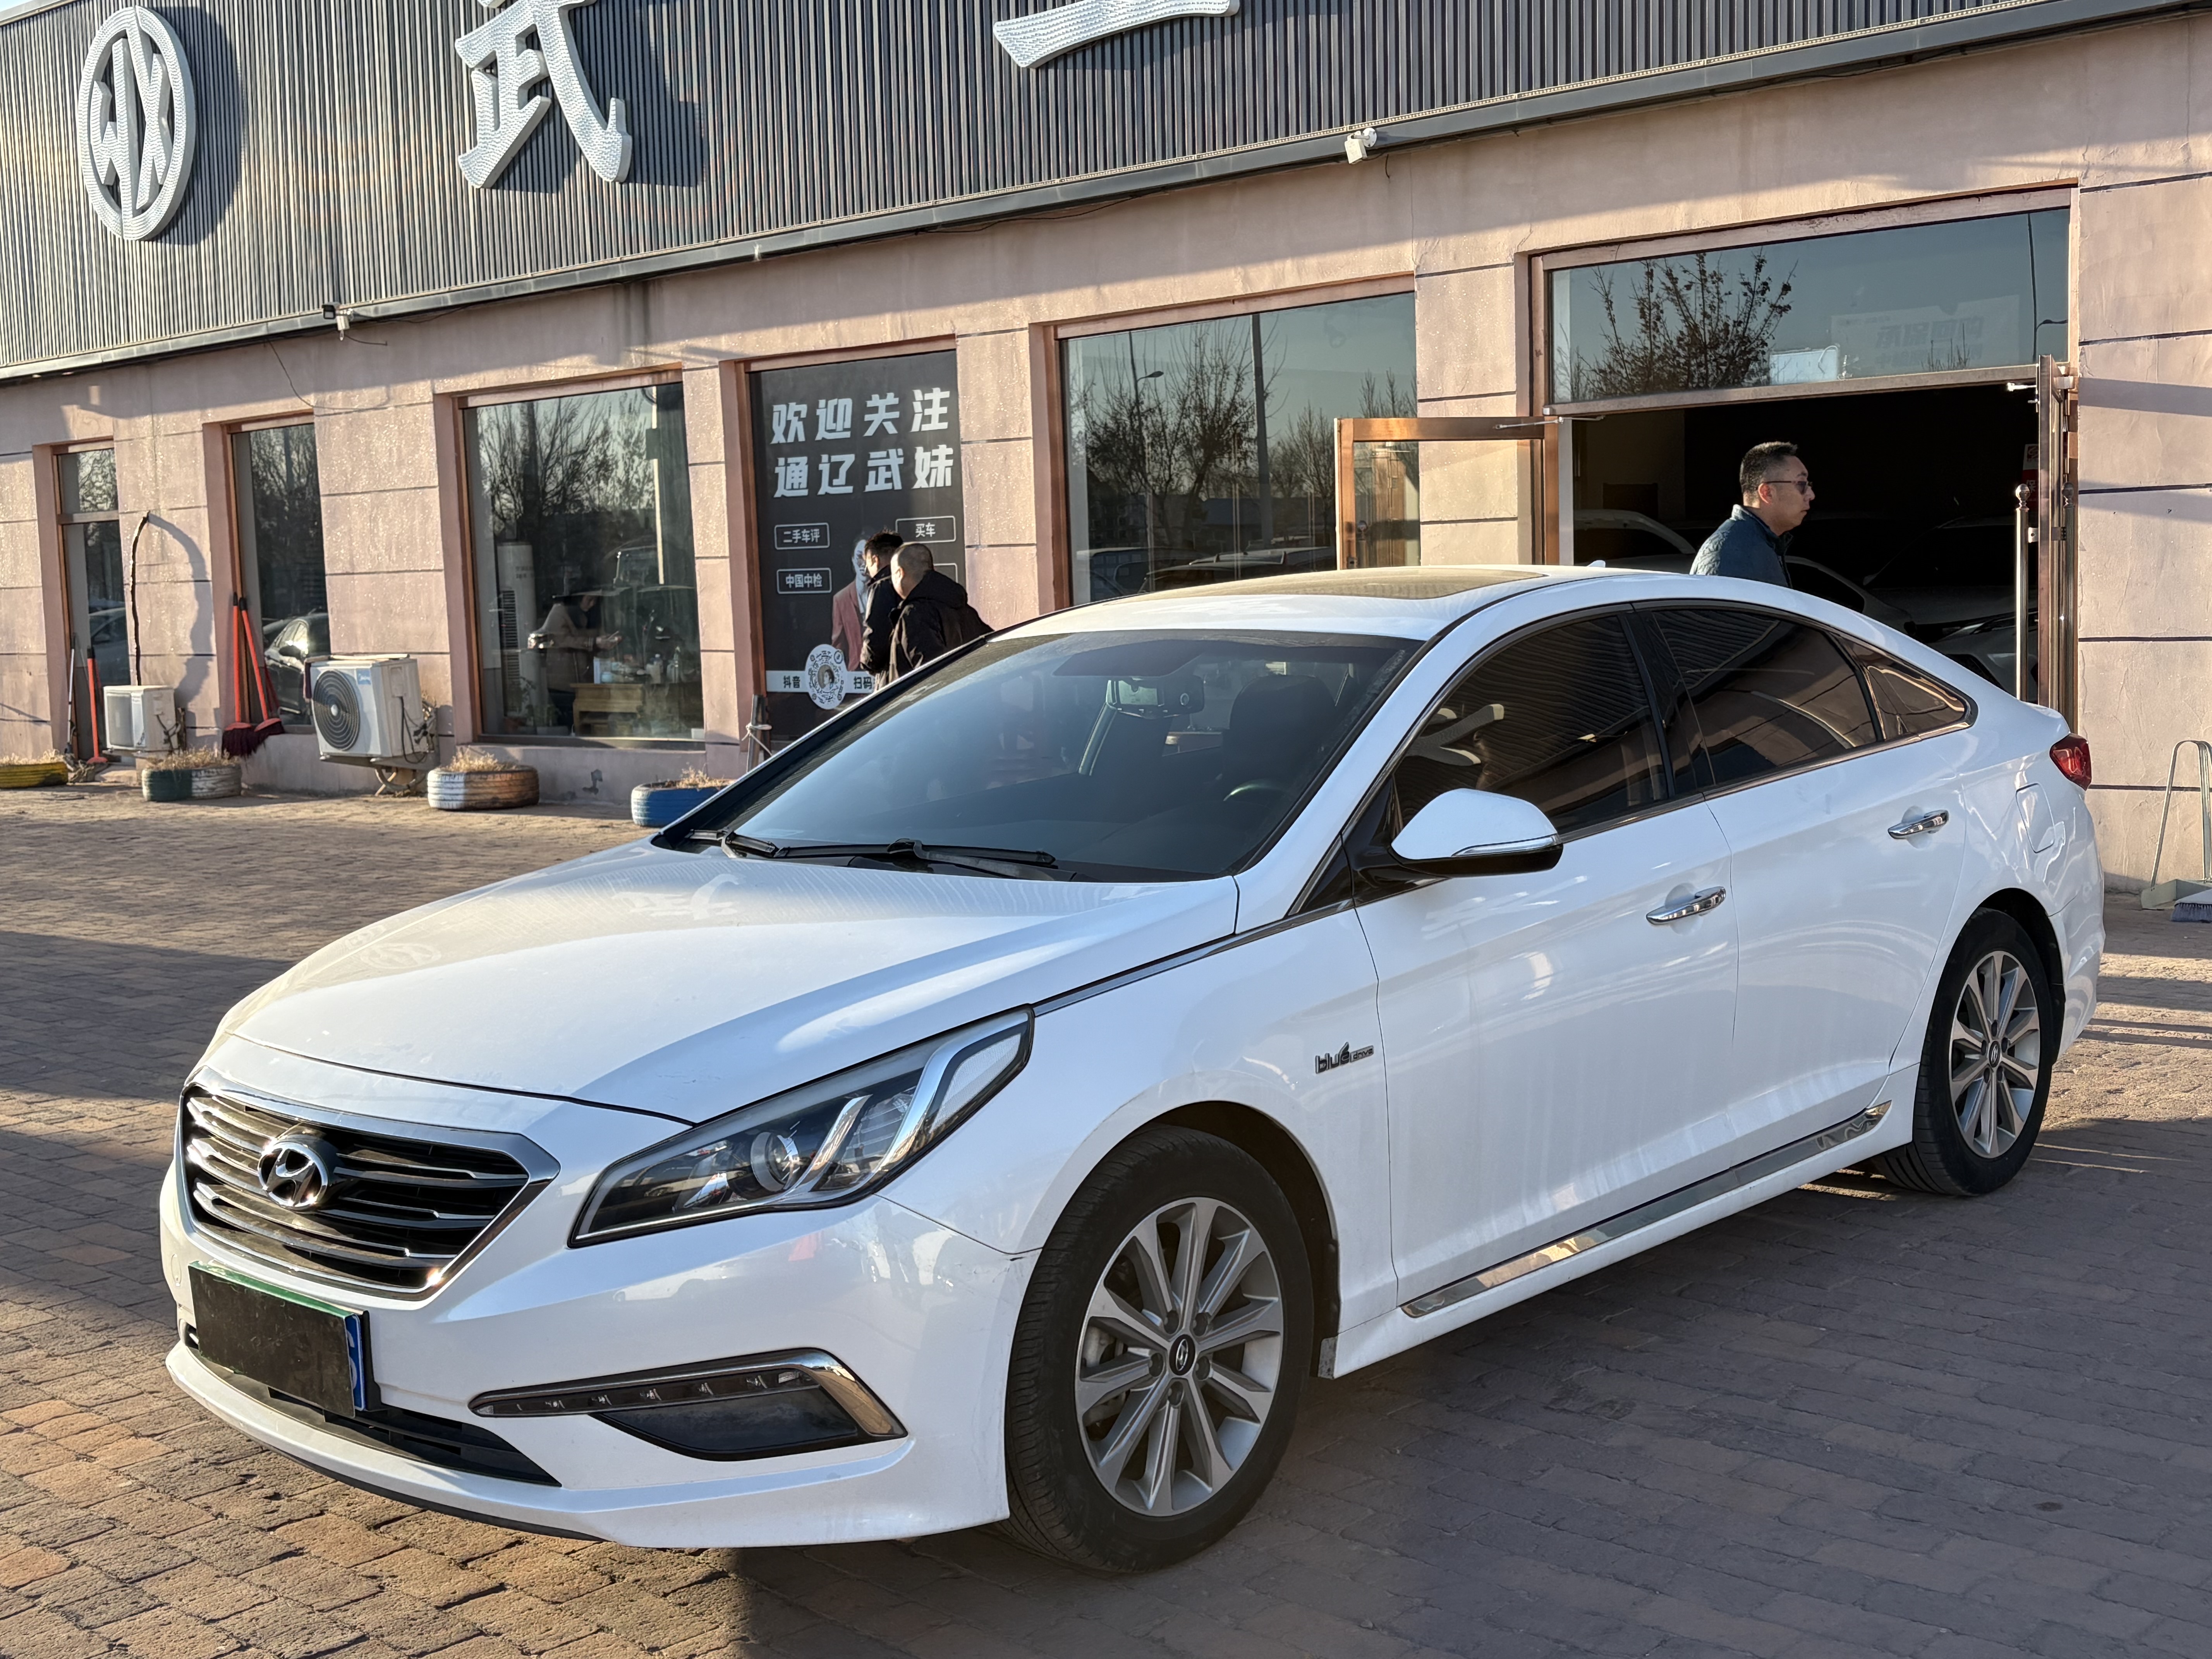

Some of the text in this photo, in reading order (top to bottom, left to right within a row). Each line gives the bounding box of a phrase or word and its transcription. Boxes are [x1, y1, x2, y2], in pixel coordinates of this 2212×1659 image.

[771, 387, 951, 444] 欢迎关注
[774, 444, 954, 498] 通辽武妹
[783, 529, 820, 543] 二手车评
[915, 522, 936, 538] 买车
[785, 573, 823, 588] 中国中检
[783, 675, 876, 690] 抖音 扫码
[1315, 1042, 1373, 1074] blue drive
